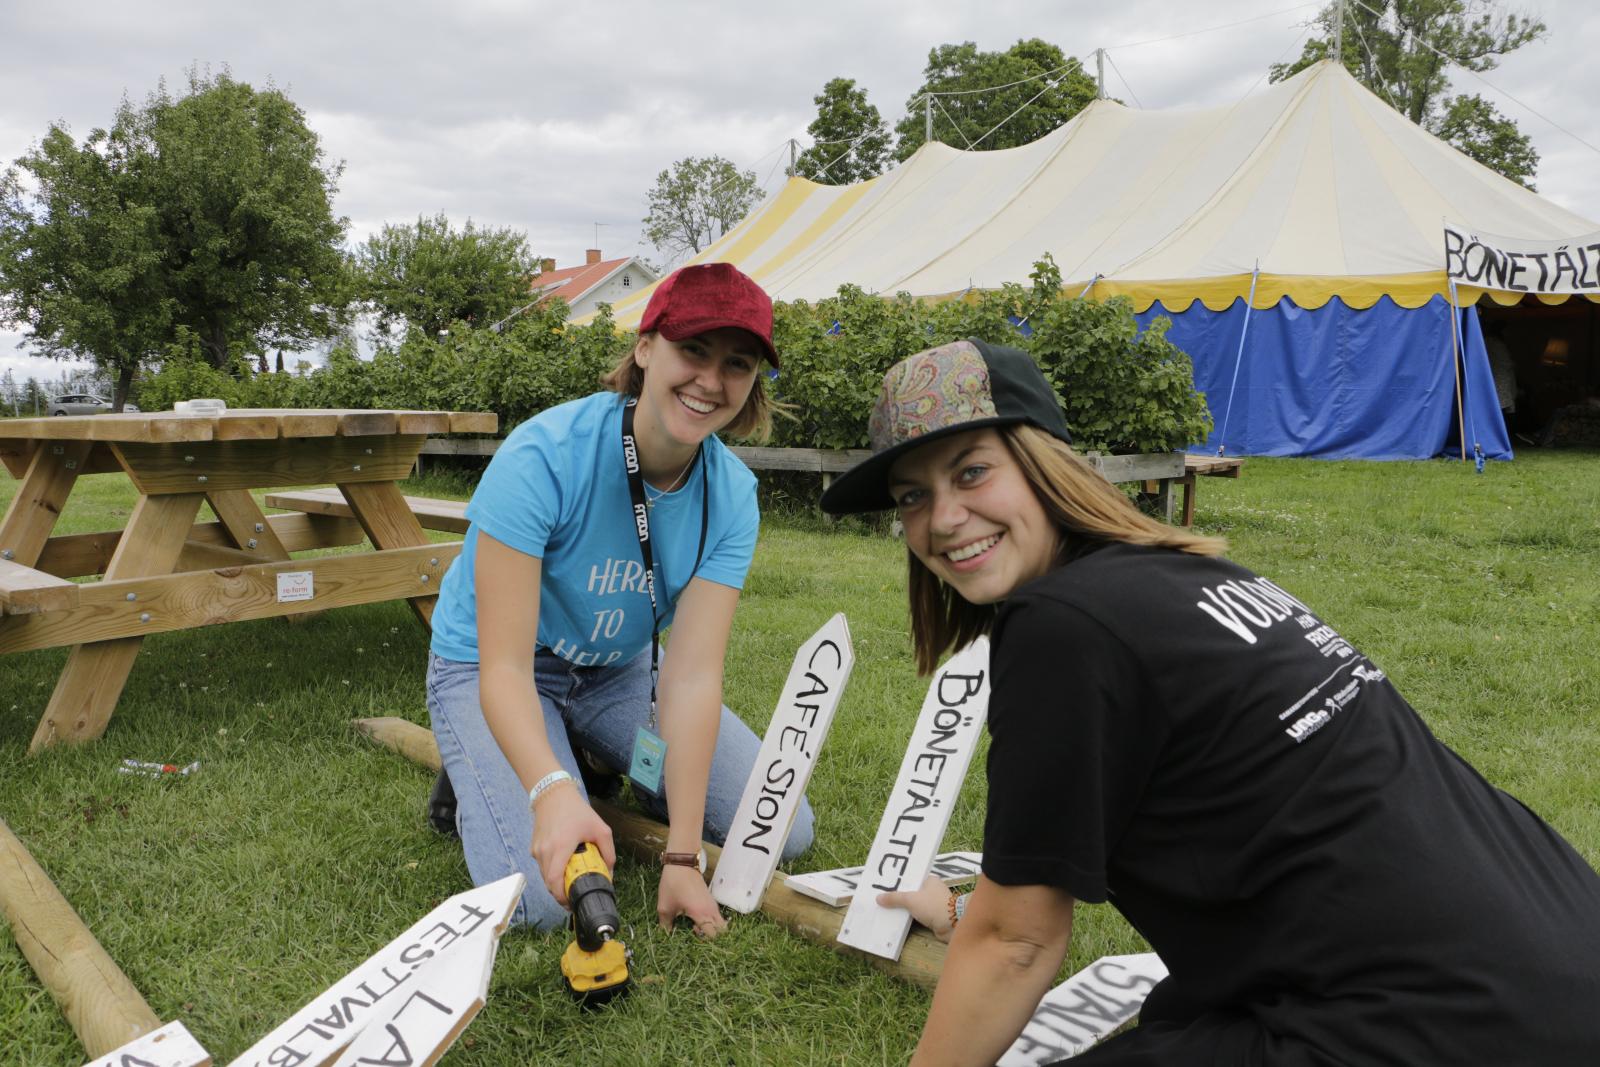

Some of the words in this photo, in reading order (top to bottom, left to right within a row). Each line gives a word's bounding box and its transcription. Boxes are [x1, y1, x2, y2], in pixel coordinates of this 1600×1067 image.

[590, 608, 625, 643] TO
[780, 639, 843, 760] CAFÉ
[742, 759, 795, 855] SION
[255, 903, 495, 1067] FESTIVALB
